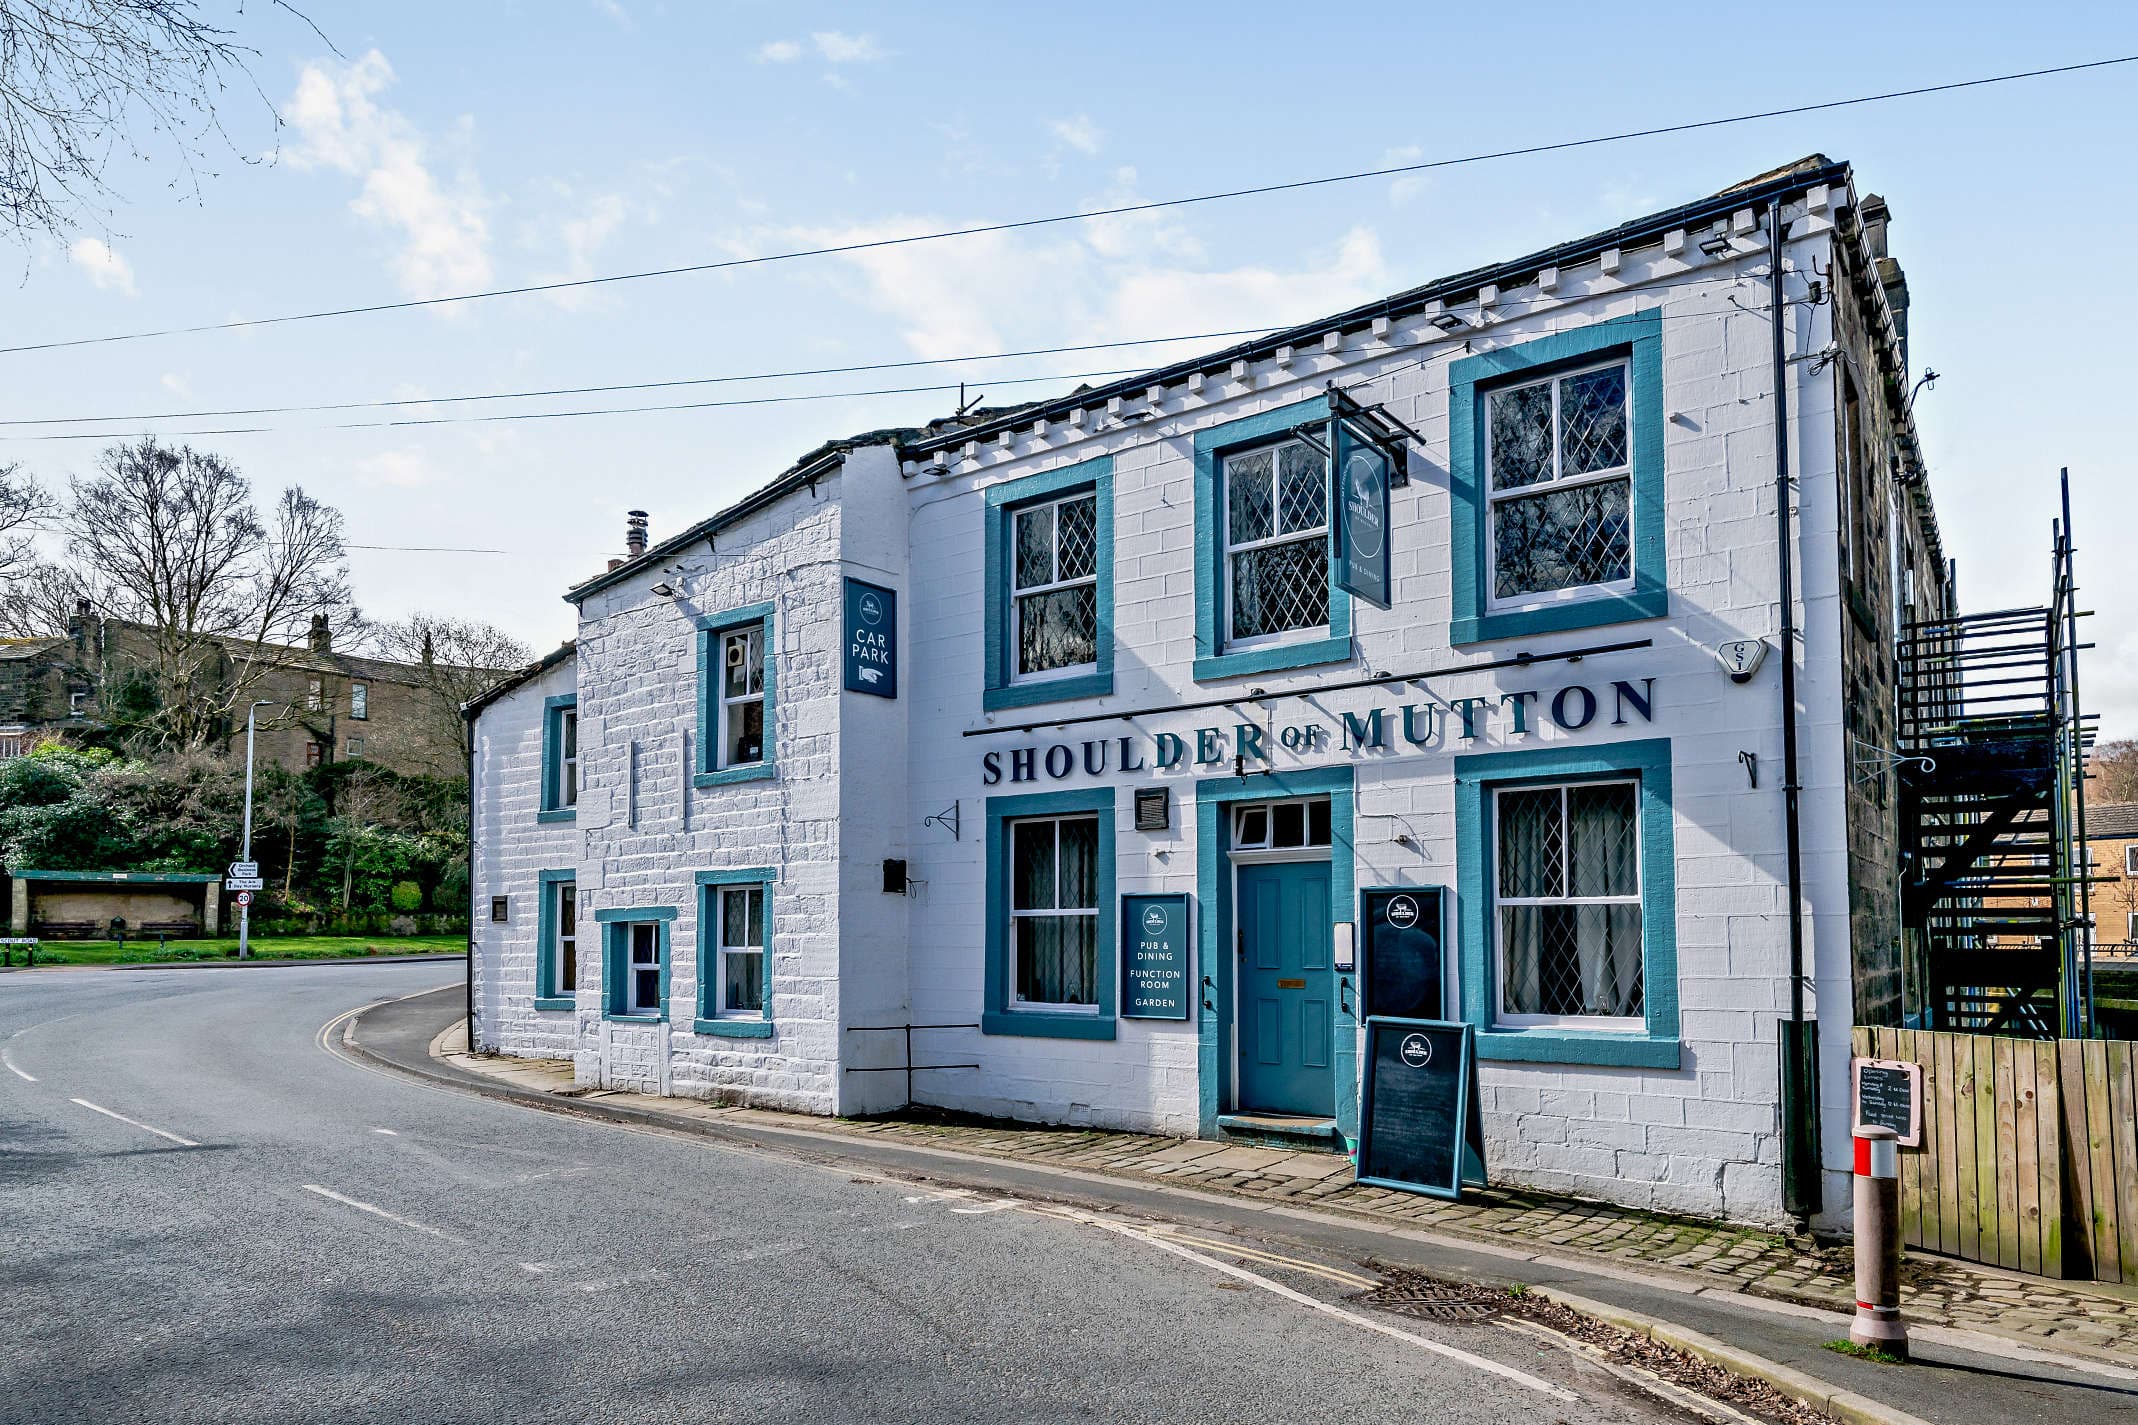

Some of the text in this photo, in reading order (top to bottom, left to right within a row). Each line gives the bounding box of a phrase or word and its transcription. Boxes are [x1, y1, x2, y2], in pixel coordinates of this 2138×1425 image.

[856, 629, 886, 648] CAR
[852, 643, 889, 665] PARK
[983, 677, 1657, 786] SHOULDER OF MUTTON
[1140, 941, 1169, 950] PUB &
[1137, 952, 1173, 961] DINING
[1130, 969, 1180, 979] FUNCTION
[1140, 980, 1170, 989] ROOM
[1135, 998, 1175, 1007] GARDEN
